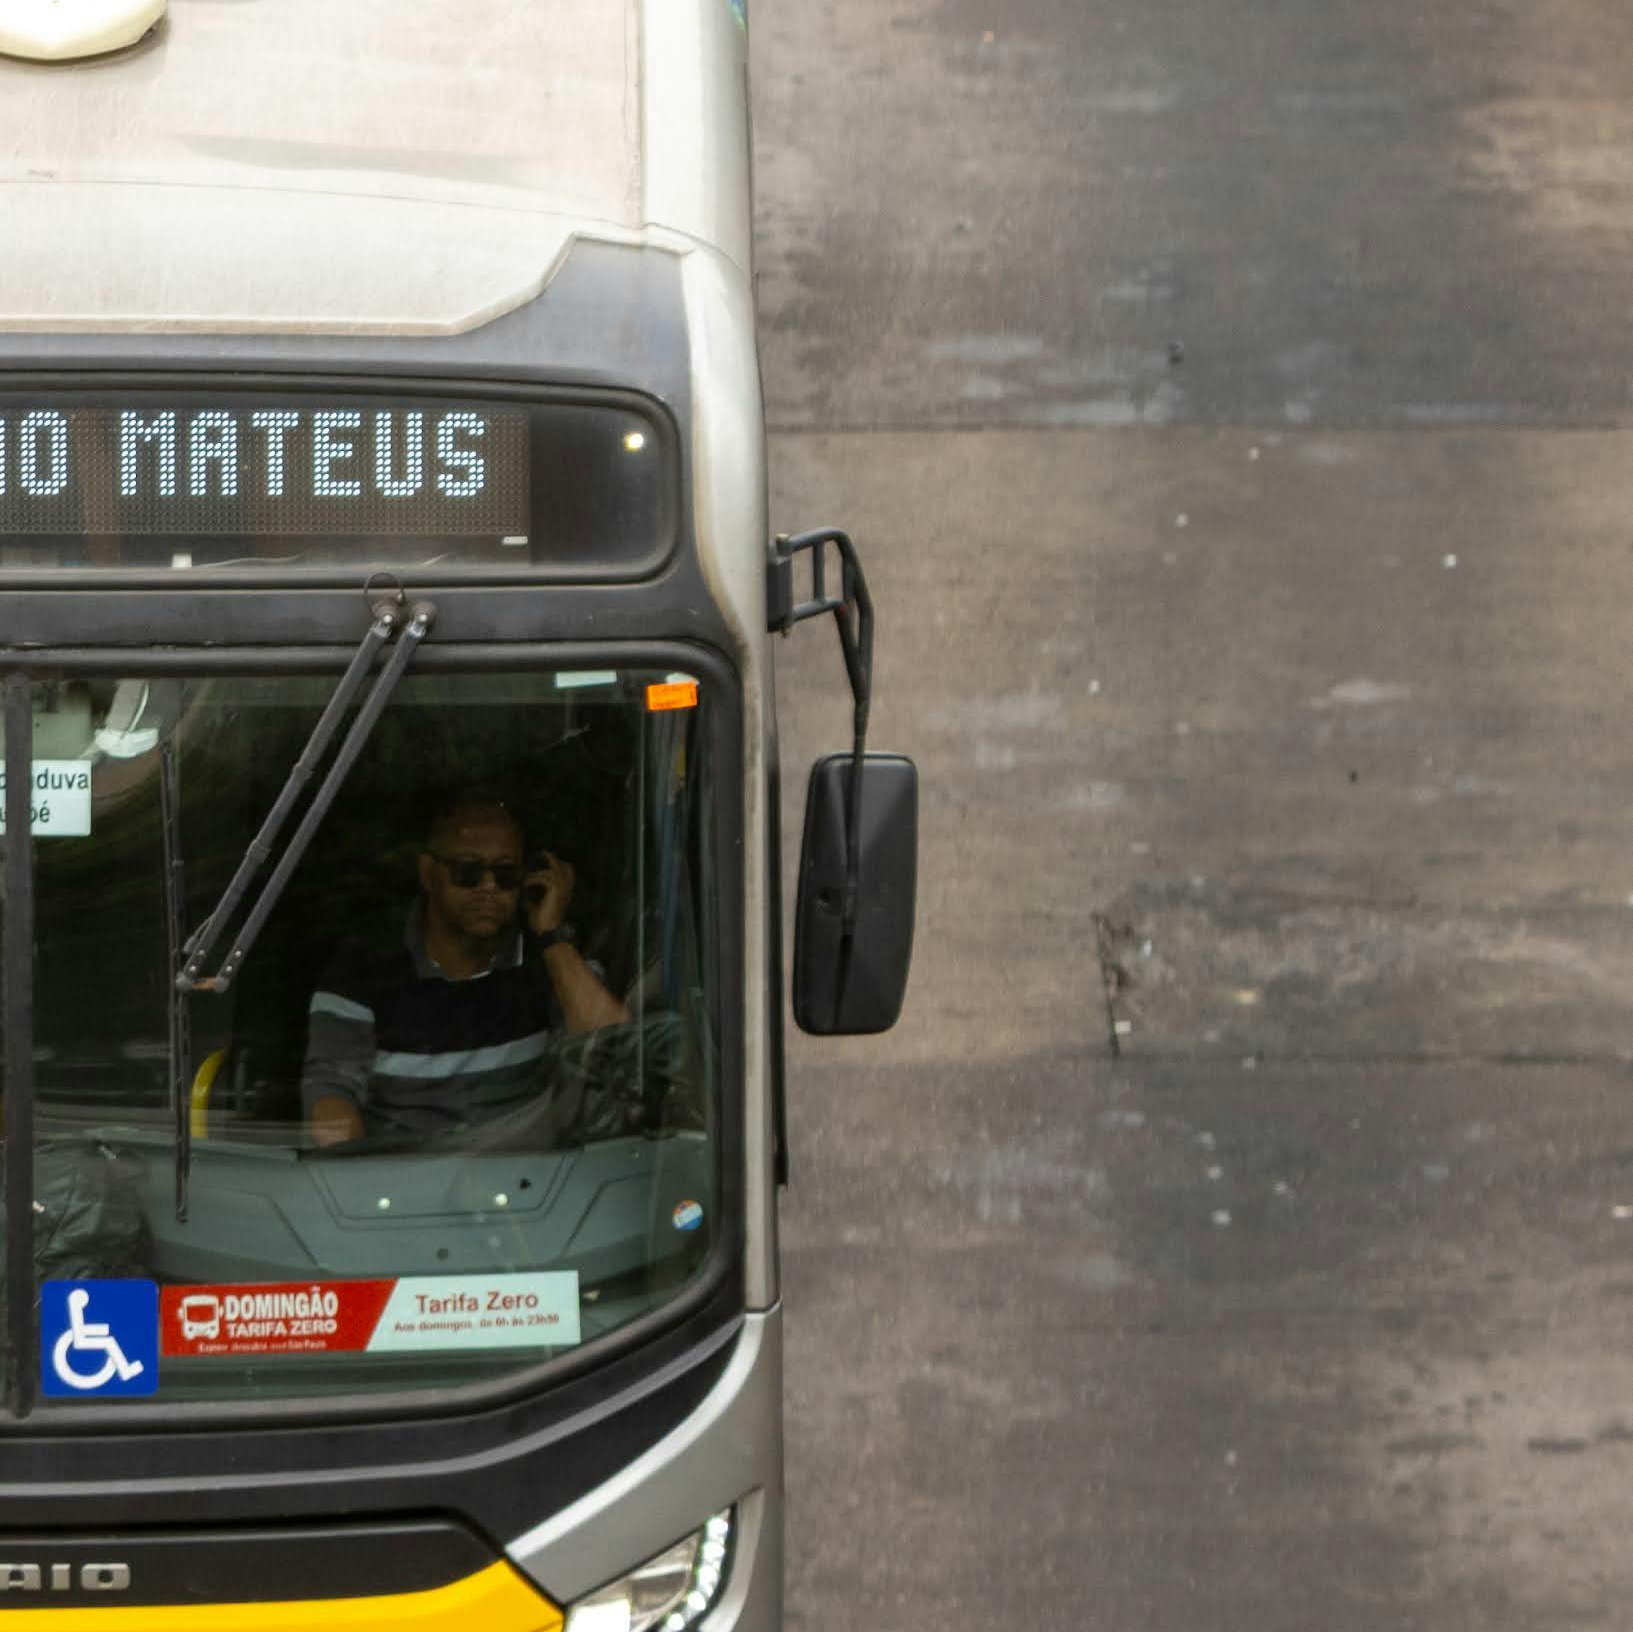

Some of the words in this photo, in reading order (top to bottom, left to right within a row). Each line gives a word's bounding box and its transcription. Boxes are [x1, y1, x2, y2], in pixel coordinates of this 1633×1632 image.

[120, 411, 485, 496] MATEUS
[225, 1286, 339, 1321] DOMINGÃO
[415, 1293, 478, 1315] Tarifa
[486, 1291, 539, 1311] Zero
[227, 1321, 287, 1338] TARIFA
[290, 1319, 338, 1336] ZERO
